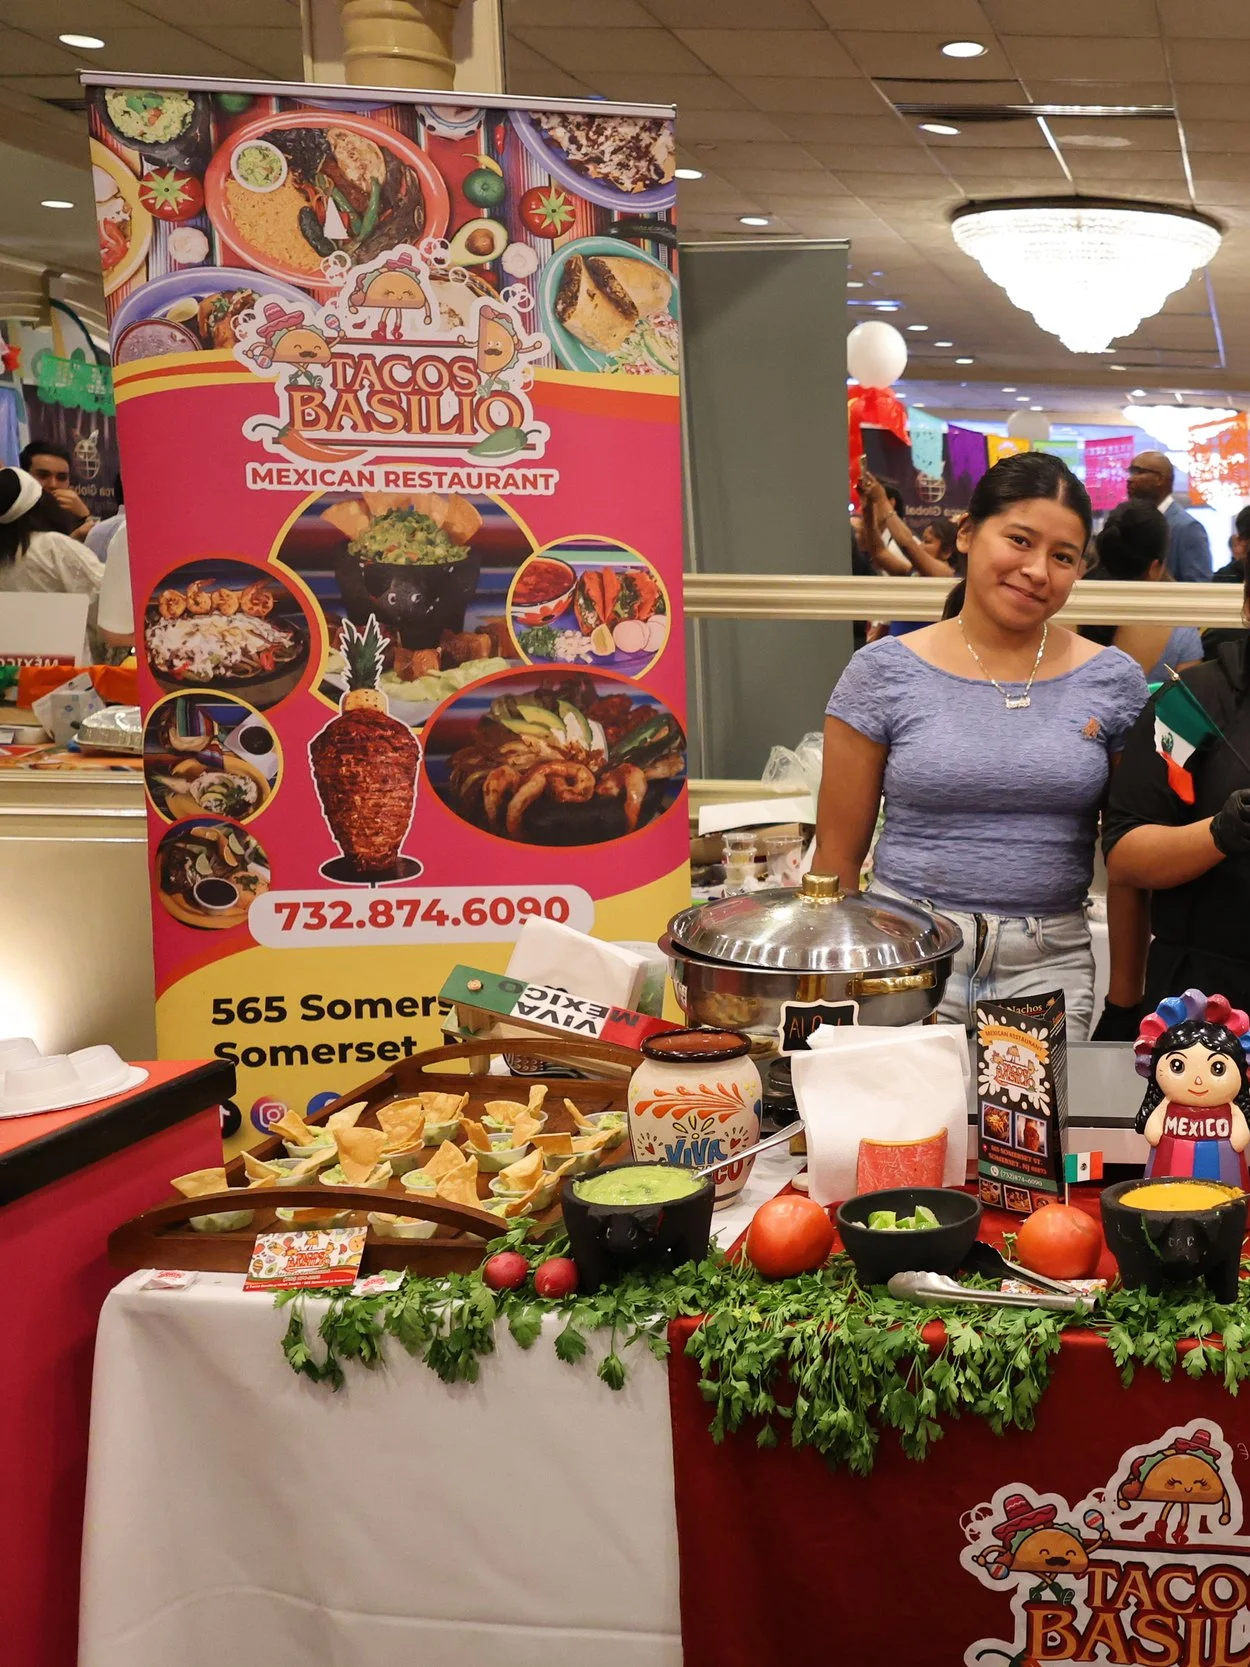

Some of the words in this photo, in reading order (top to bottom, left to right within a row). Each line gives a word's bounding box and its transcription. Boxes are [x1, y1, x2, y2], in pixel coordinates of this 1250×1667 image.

[323, 353, 482, 393] TACOS
[284, 384, 525, 436] BASILIO
[251, 467, 375, 489] MEXICAN
[384, 470, 554, 491] RESTAURANT
[274, 896, 571, 932] 732.874.6090
[211, 995, 288, 1026] 565
[499, 979, 641, 1027] MÉXICO
[517, 1001, 598, 1034] VIVA
[214, 1036, 417, 1068] Somerset
[1164, 1116, 1230, 1137] MEXICO
[665, 1138, 728, 1166] VIVA
